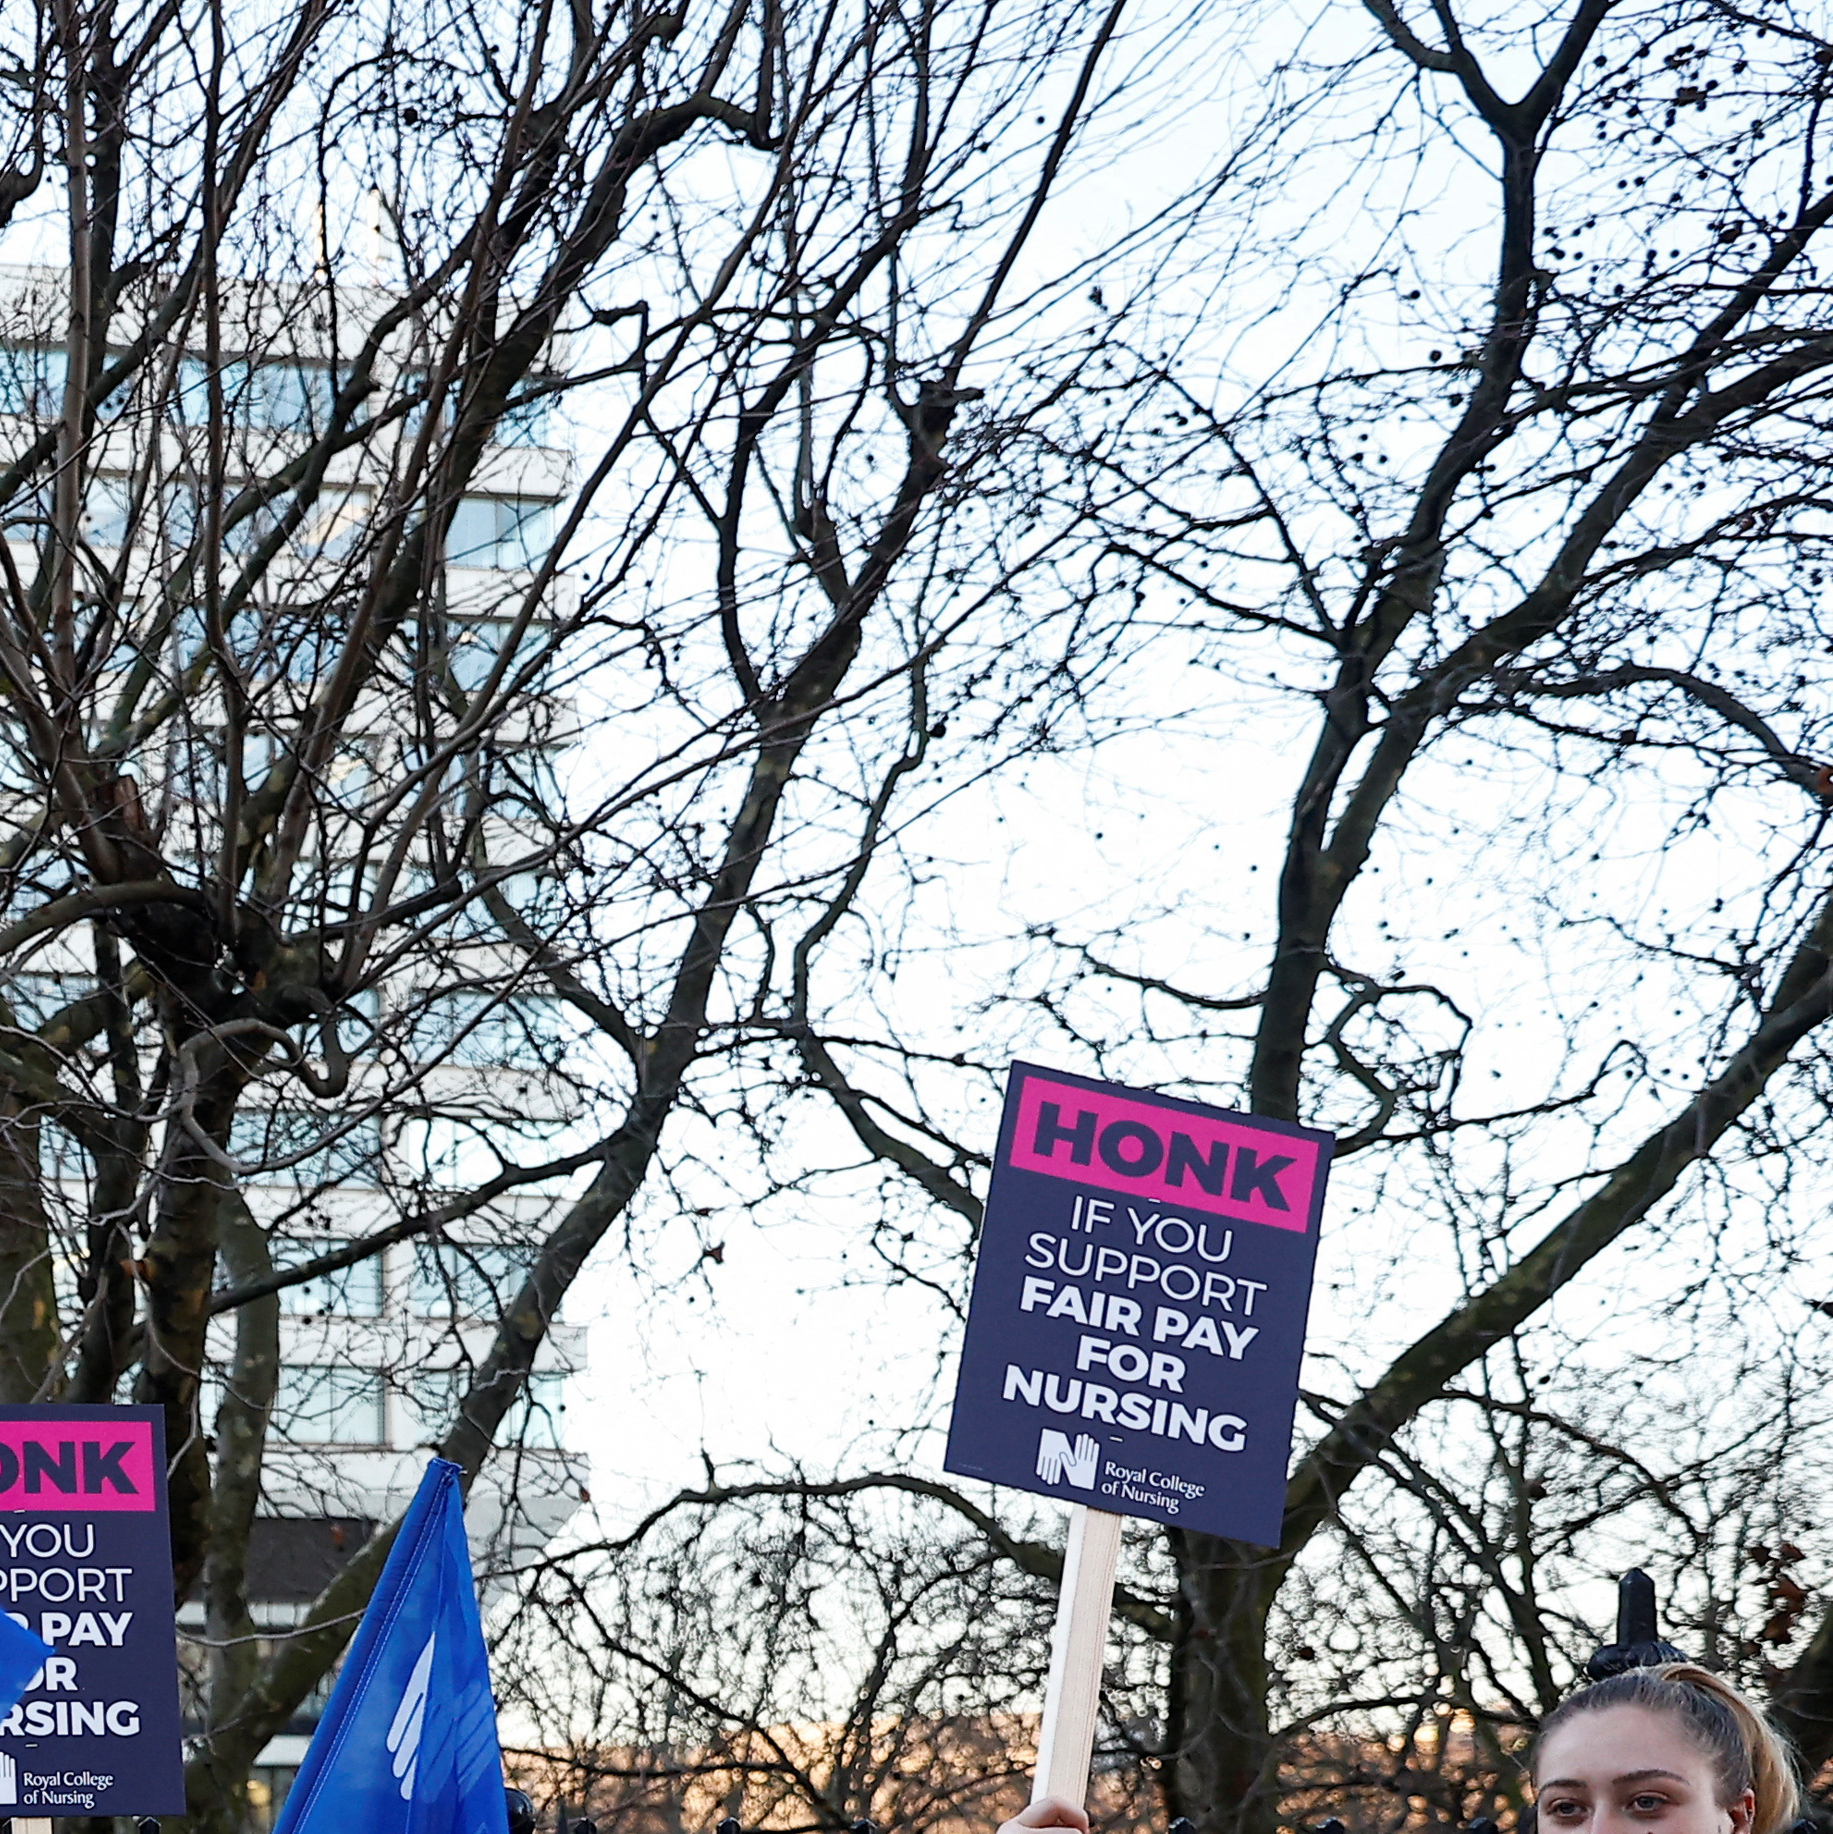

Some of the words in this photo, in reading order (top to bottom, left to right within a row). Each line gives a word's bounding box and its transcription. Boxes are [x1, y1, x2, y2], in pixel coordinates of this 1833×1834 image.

[1033, 1101, 1298, 1213] HONK
[1071, 1195, 1115, 1234] IF
[1127, 1206, 1232, 1262] YOU
[1025, 1232, 1268, 1316] SUPPORT
[1019, 1275, 1143, 1337] FAIR
[1153, 1305, 1259, 1360] PAY
[1075, 1334, 1187, 1393] FOR
[1002, 1364, 1248, 1453] NURSING
[1101, 1482, 1120, 1498] of
[1121, 1484, 1180, 1514] Nursing
[1105, 1461, 1146, 1484] Royal
[1148, 1471, 1205, 1500] College
[41, 1611, 133, 1647] PAY
[23, 1771, 61, 1789] Royal
[63, 1771, 115, 1791] College
[23, 1789, 40, 1805] of
[41, 1789, 96, 1808] Nursing
